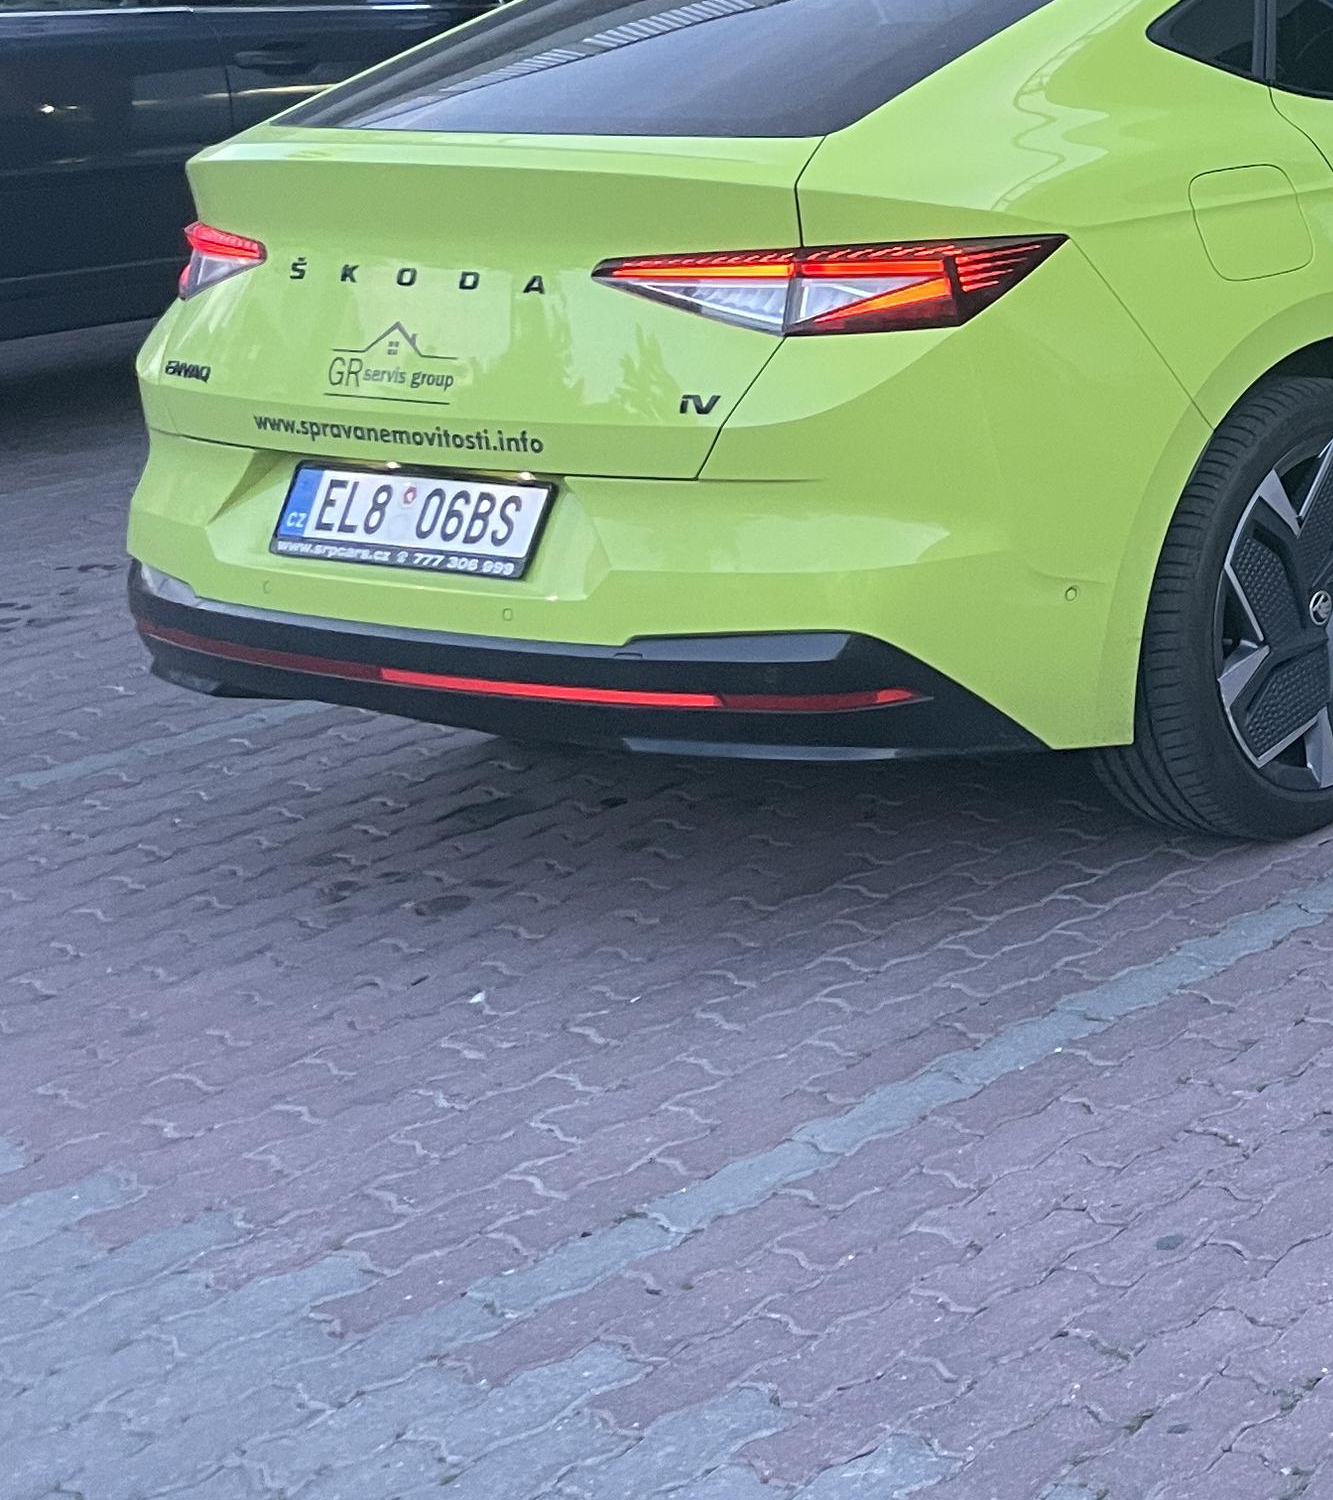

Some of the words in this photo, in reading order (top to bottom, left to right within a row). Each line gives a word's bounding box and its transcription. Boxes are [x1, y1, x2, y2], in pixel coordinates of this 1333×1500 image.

[289, 256, 547, 295] ŠKODA
[328, 356, 363, 389] GR
[362, 364, 408, 387] servis
[410, 368, 456, 392] group
[252, 412, 545, 455] www.spravanemovitosti.info
[286, 511, 306, 529] CZ
[314, 477, 395, 536] EL8
[414, 486, 523, 547] 06BS
[412, 551, 446, 568] 777
